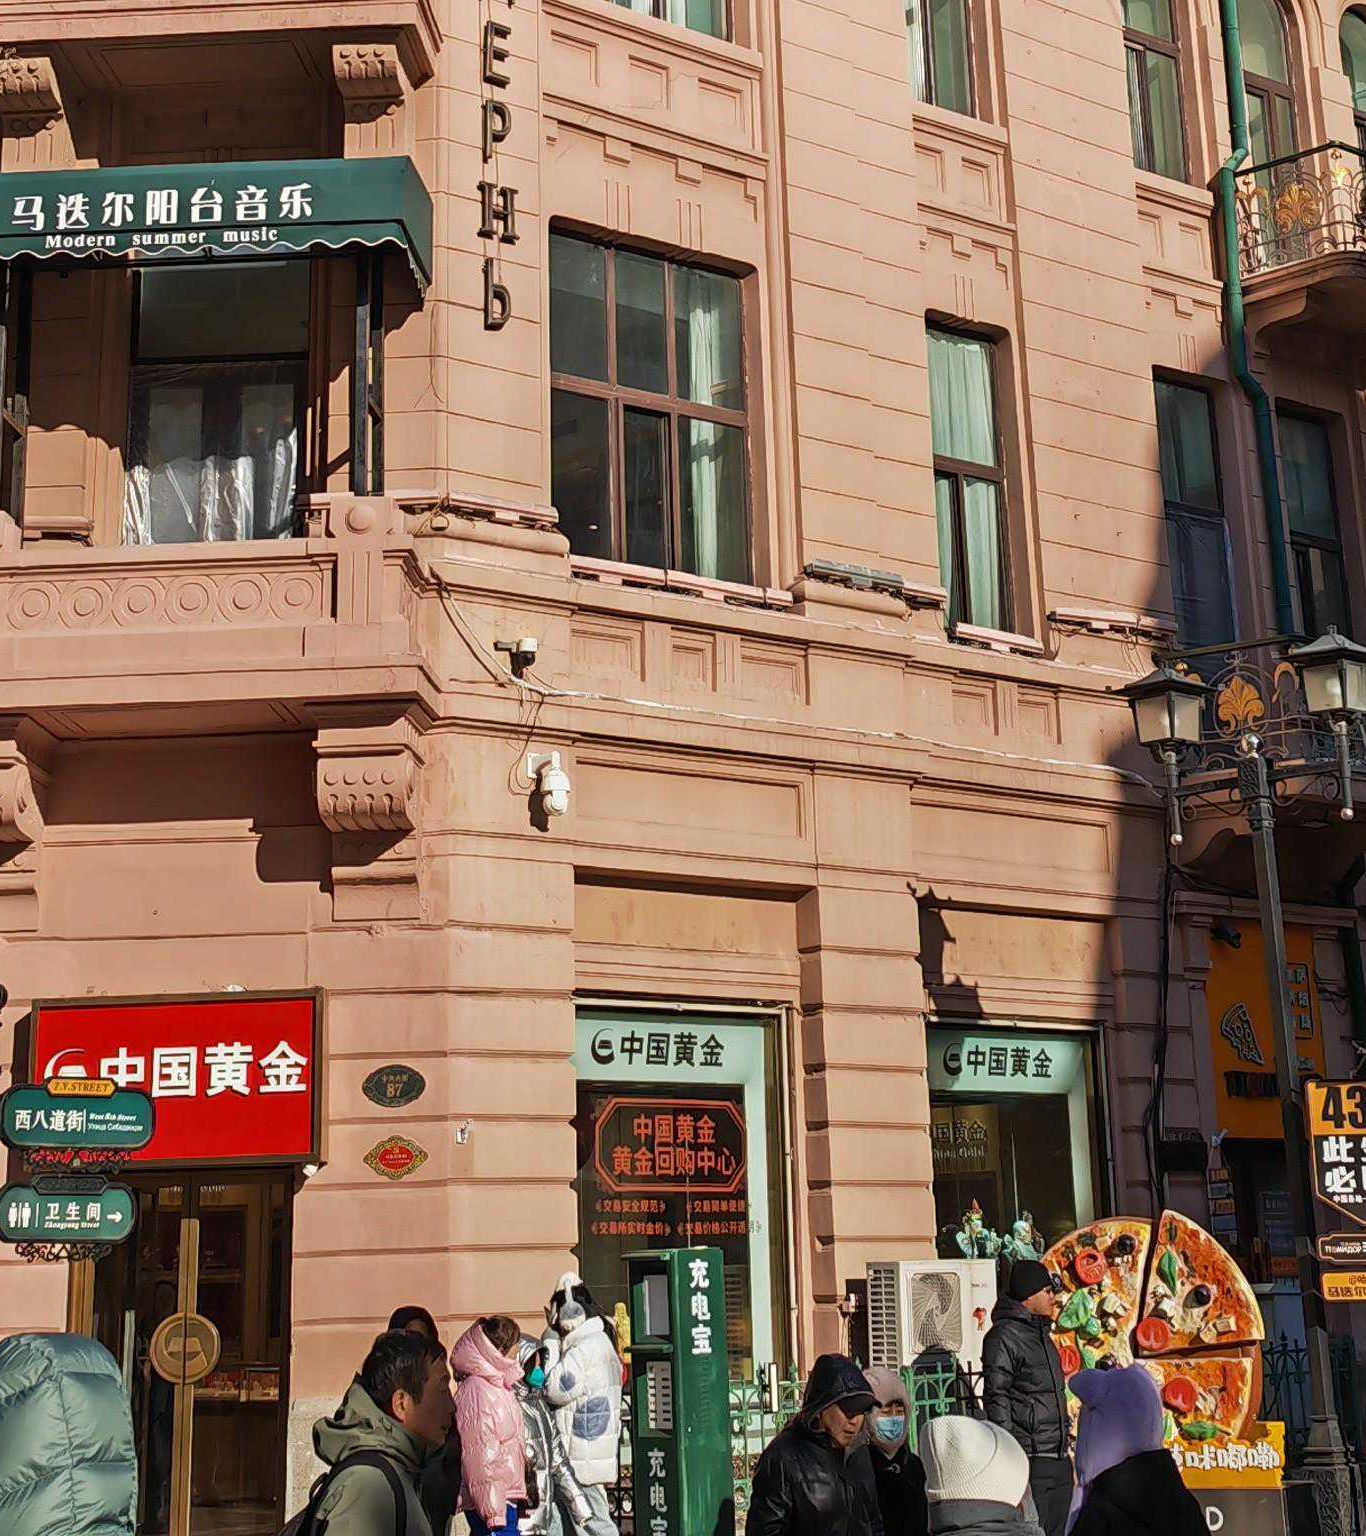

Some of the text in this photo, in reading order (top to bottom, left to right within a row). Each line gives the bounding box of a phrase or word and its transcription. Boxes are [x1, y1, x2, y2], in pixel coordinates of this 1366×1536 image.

[11, 182, 313, 231] 马迭尔阳台音乐
[45, 226, 278, 249] Modern summer music
[620, 1030, 725, 1067] 中国黄金
[966, 1044, 1053, 1078] 中国黄金
[99, 1040, 309, 1097] 中国黄金
[53, 1080, 111, 1093] Z.Y.STREET
[386, 1084, 403, 1097] 87
[14, 1109, 84, 1133] 西八道街
[633, 1114, 717, 1144] 中国黄金
[612, 1145, 736, 1177] 黄金回购中心
[45, 1202, 101, 1221] 卫生间
[688, 1258, 712, 1355] 充电宝
